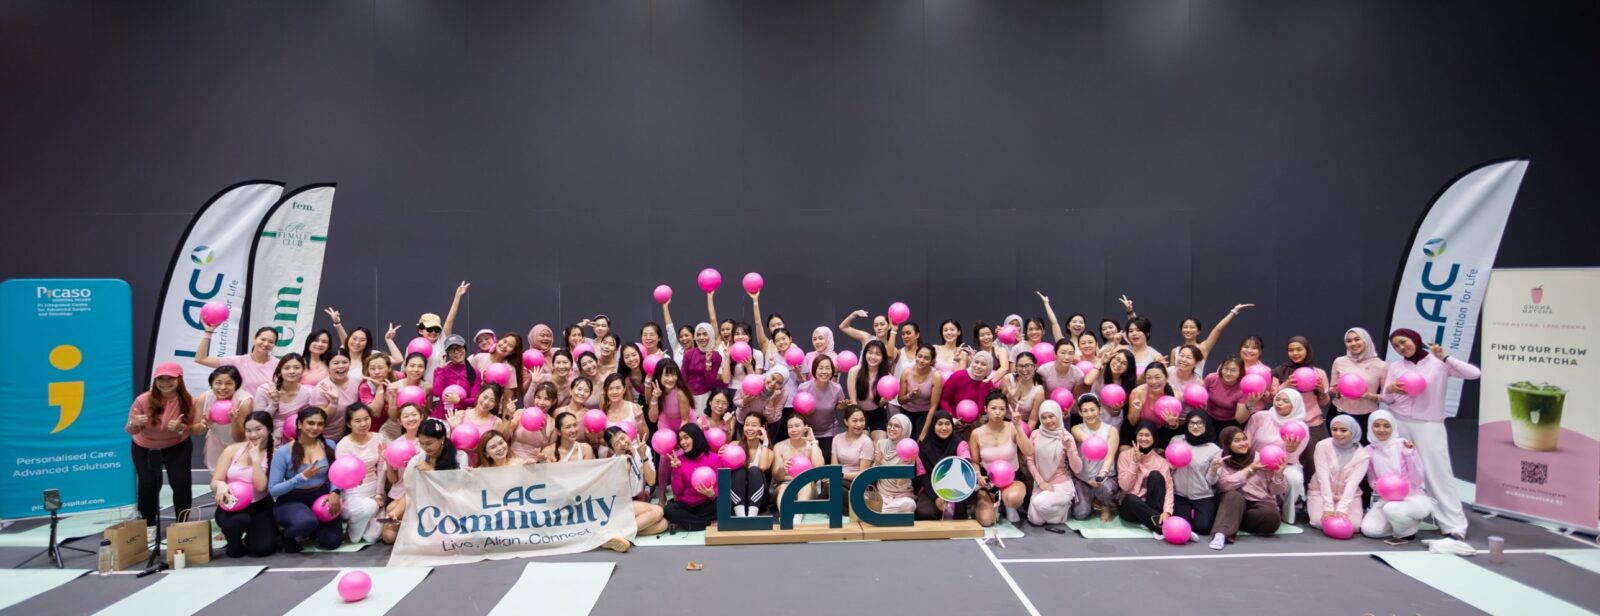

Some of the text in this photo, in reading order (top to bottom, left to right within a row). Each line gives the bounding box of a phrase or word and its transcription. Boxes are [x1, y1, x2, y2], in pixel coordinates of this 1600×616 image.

[37, 286, 91, 298] Picaso
[229, 279, 238, 297] Life
[1450, 268, 1478, 349] Nutrition for Life
[272, 276, 304, 359] em.
[1491, 343, 1587, 356] FIND YOUR FLOW
[1497, 354, 1578, 366] WITH MATCHA
[16, 452, 87, 466] Personalised
[12, 462, 121, 478] Advanced Solutions
[481, 483, 546, 509] LAC
[717, 464, 915, 531] LAC
[31, 498, 105, 512] picospital.com
[417, 495, 615, 538] Community
